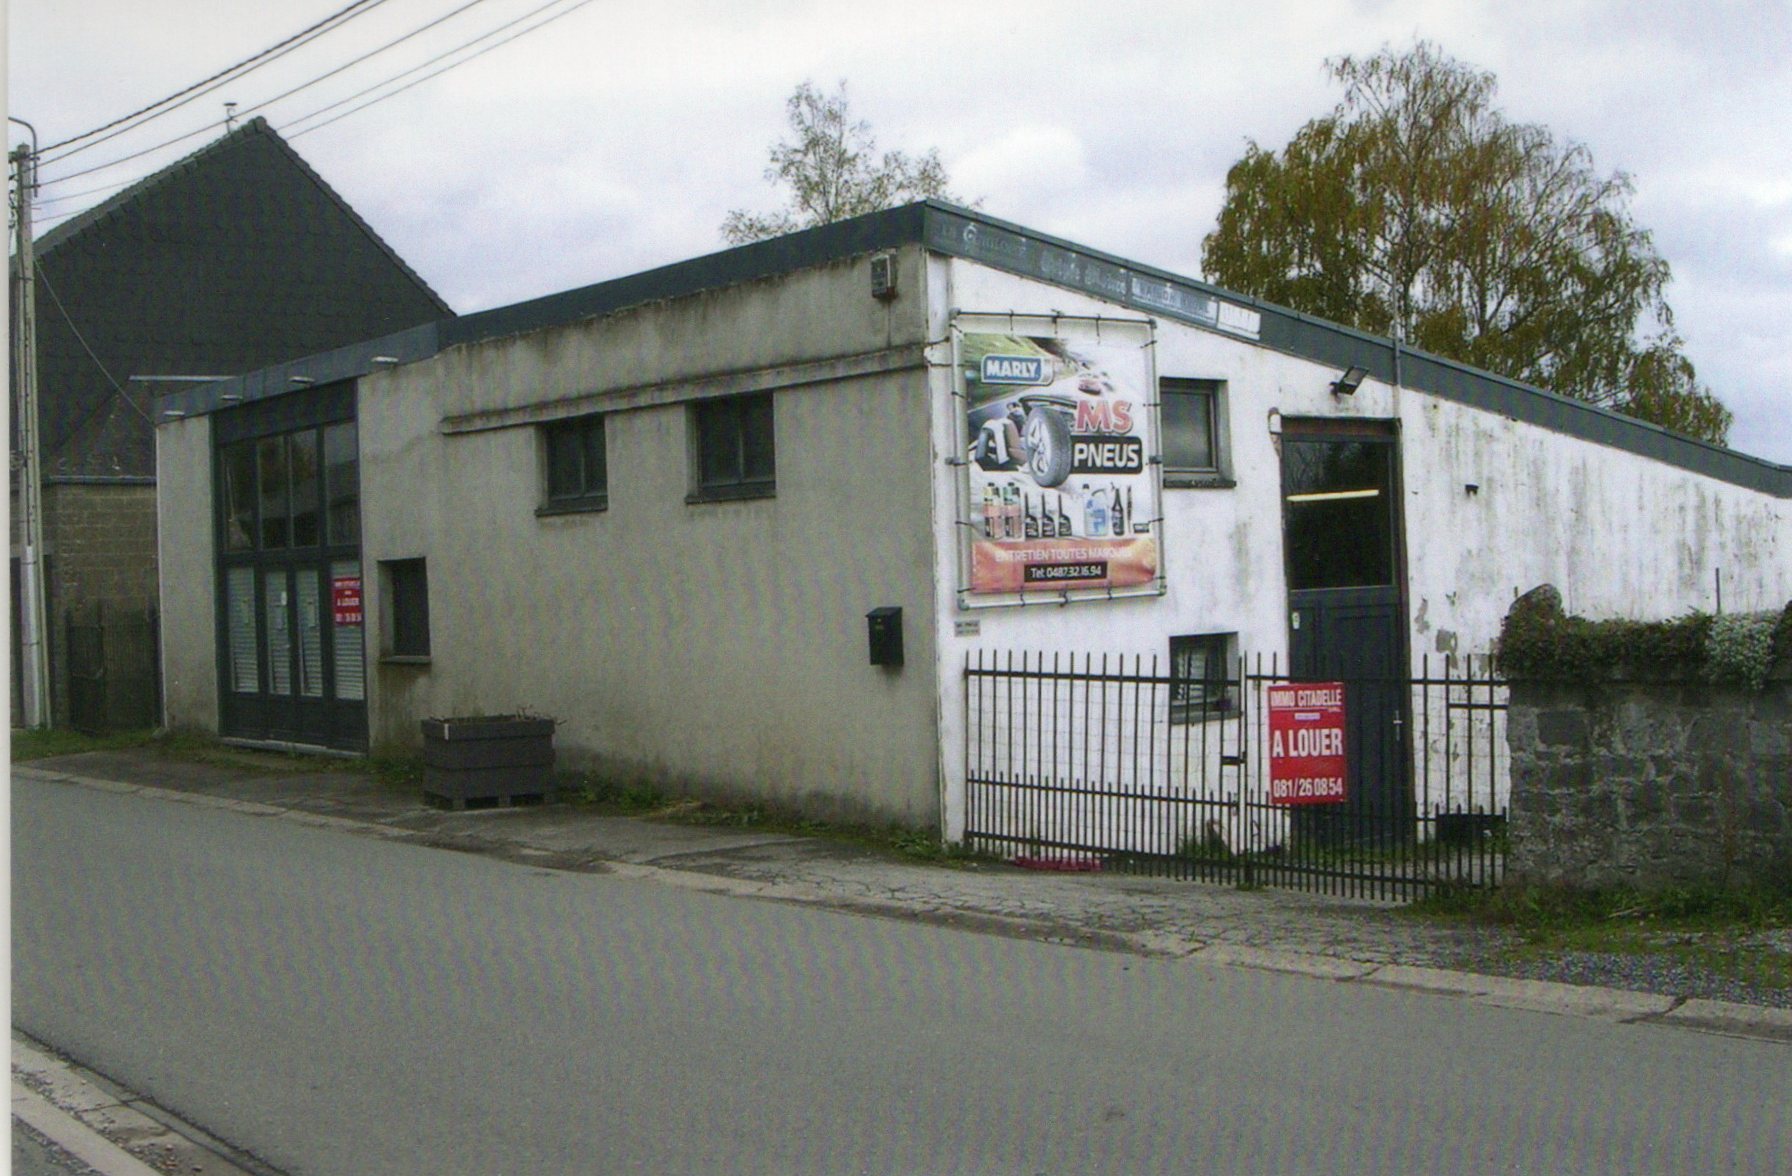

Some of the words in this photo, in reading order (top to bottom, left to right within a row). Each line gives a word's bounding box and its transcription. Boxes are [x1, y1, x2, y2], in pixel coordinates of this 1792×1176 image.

[986, 360, 1038, 378] MARLY
[1076, 400, 1133, 434] MS
[1073, 443, 1139, 468] PNEUS
[995, 549, 1049, 562] ENTRETIEN
[1051, 548, 1088, 560] TOUTES
[1270, 690, 1295, 707] IMMO
[1298, 688, 1342, 706] CITADELLE
[1272, 730, 1284, 757] A
[1288, 728, 1344, 757] LOUER
